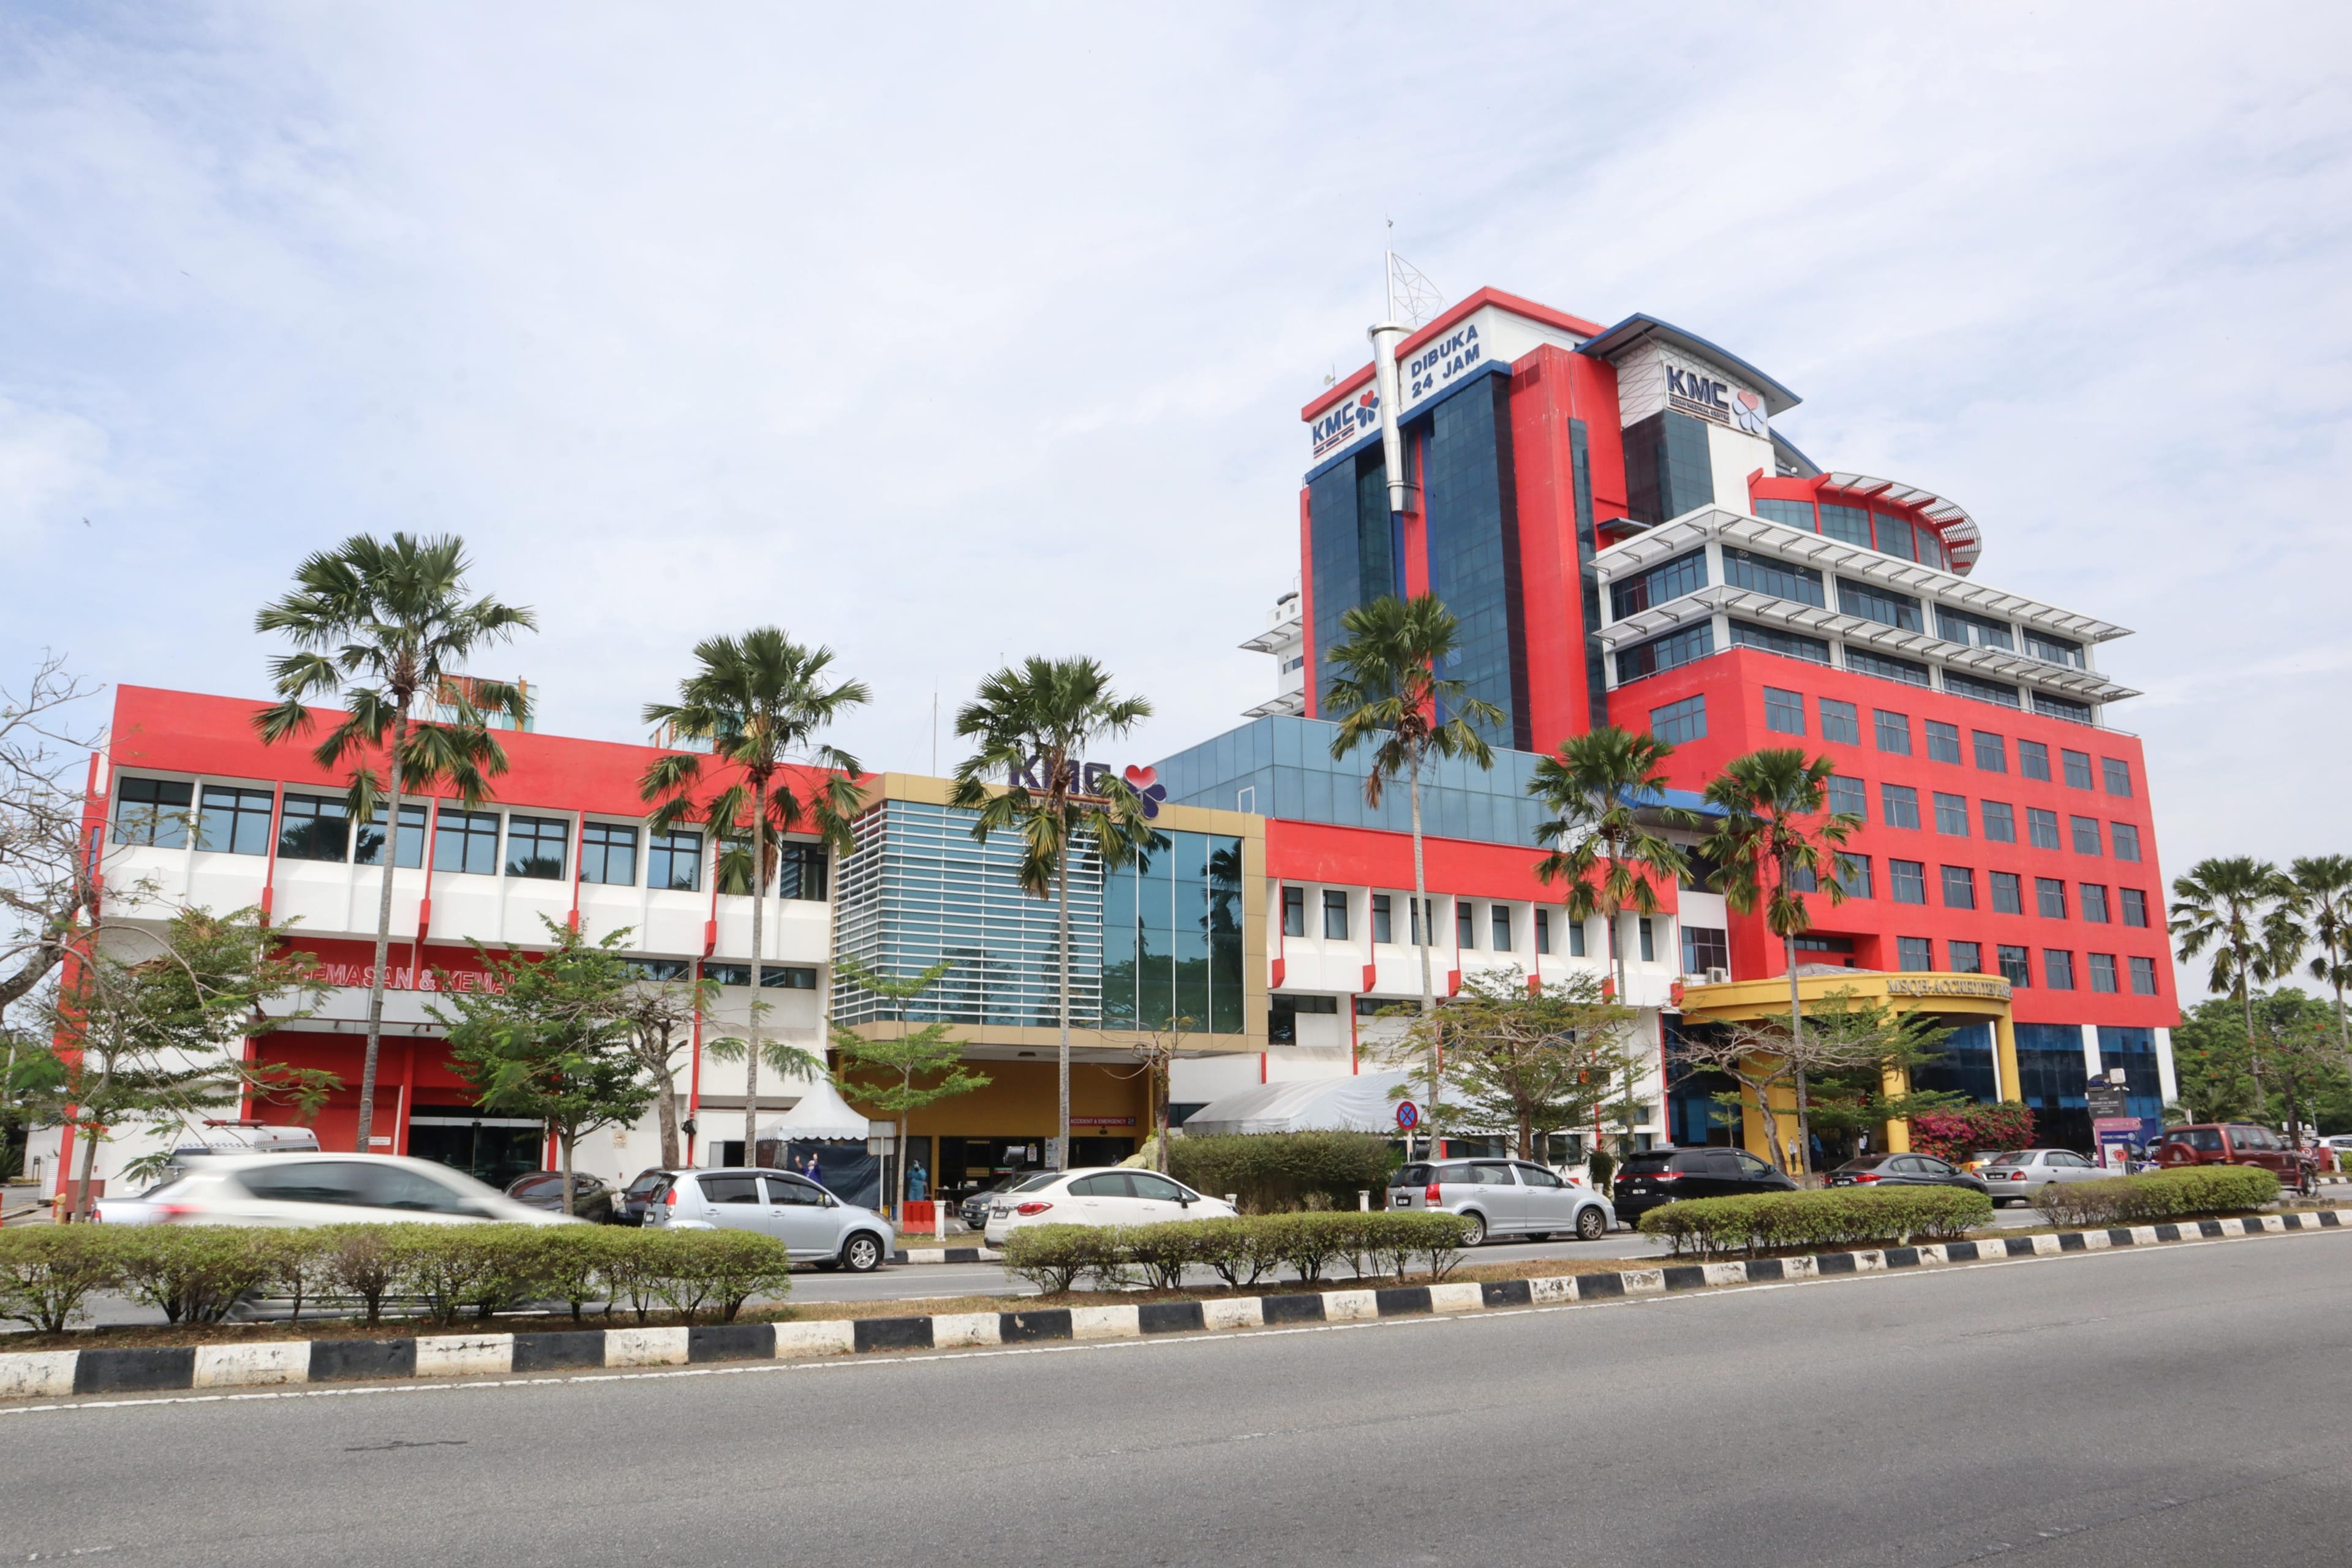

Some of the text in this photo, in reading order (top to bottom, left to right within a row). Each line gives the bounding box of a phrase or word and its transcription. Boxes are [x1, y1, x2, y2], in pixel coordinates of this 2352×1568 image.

[1411, 324, 1479, 379] DIBUKA
[1412, 343, 1480, 399] 24 JAM
[1666, 365, 1729, 410] KMC
[1313, 400, 1354, 446] KMC
[419, 969, 436, 990] &
